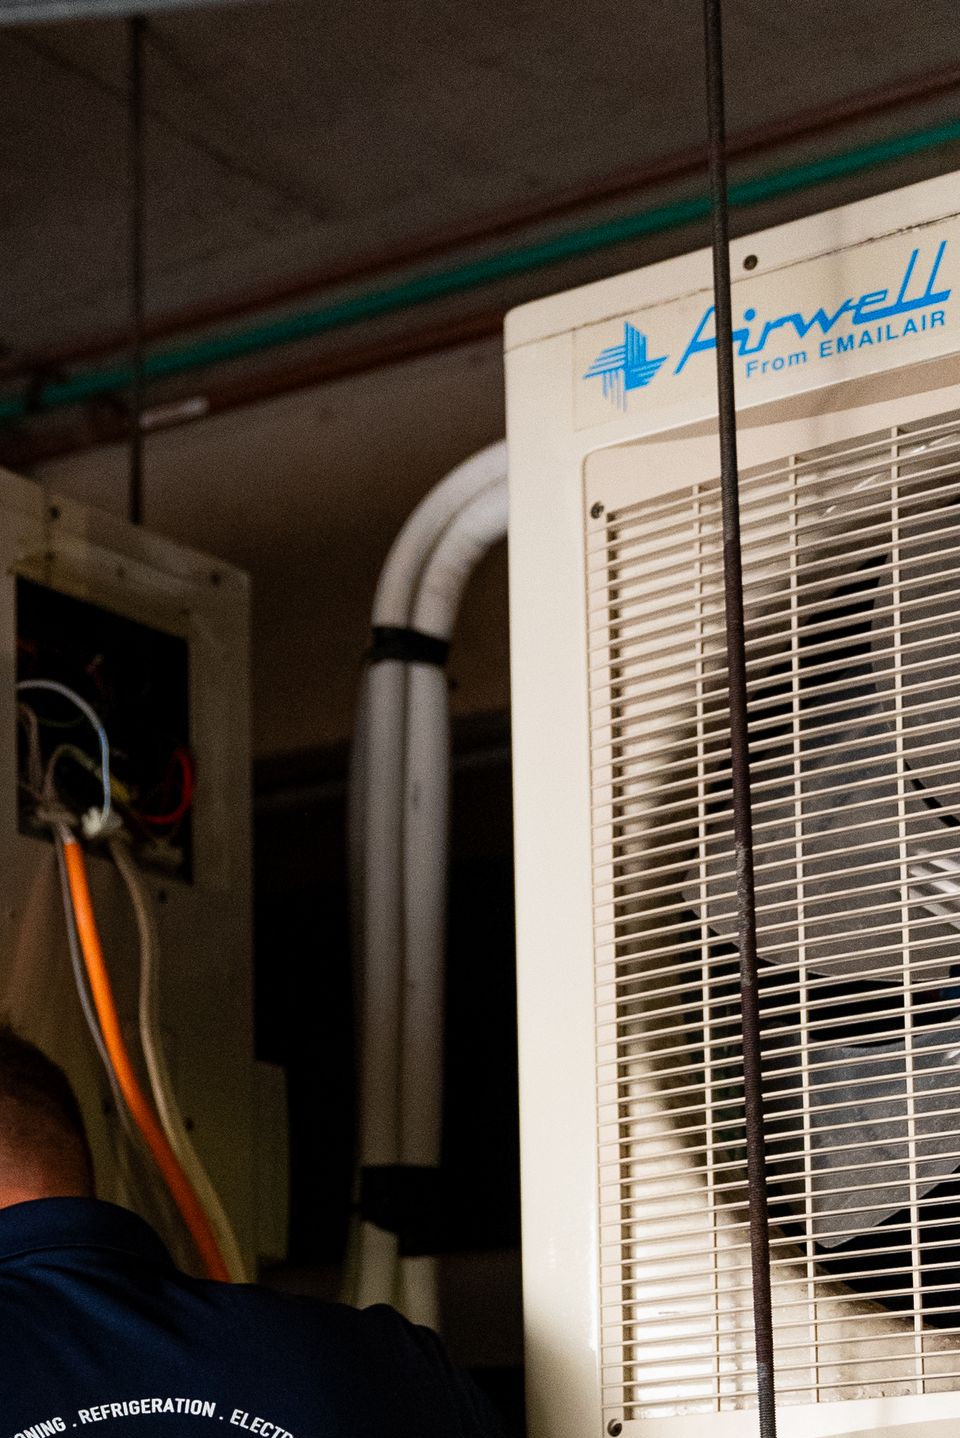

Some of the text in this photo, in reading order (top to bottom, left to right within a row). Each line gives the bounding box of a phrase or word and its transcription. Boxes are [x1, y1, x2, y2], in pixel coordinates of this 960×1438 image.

[673, 240, 952, 375] Airwell
[746, 310, 946, 378] From EMAILAIR
[78, 1397, 216, 1425] REFRIGERATION
